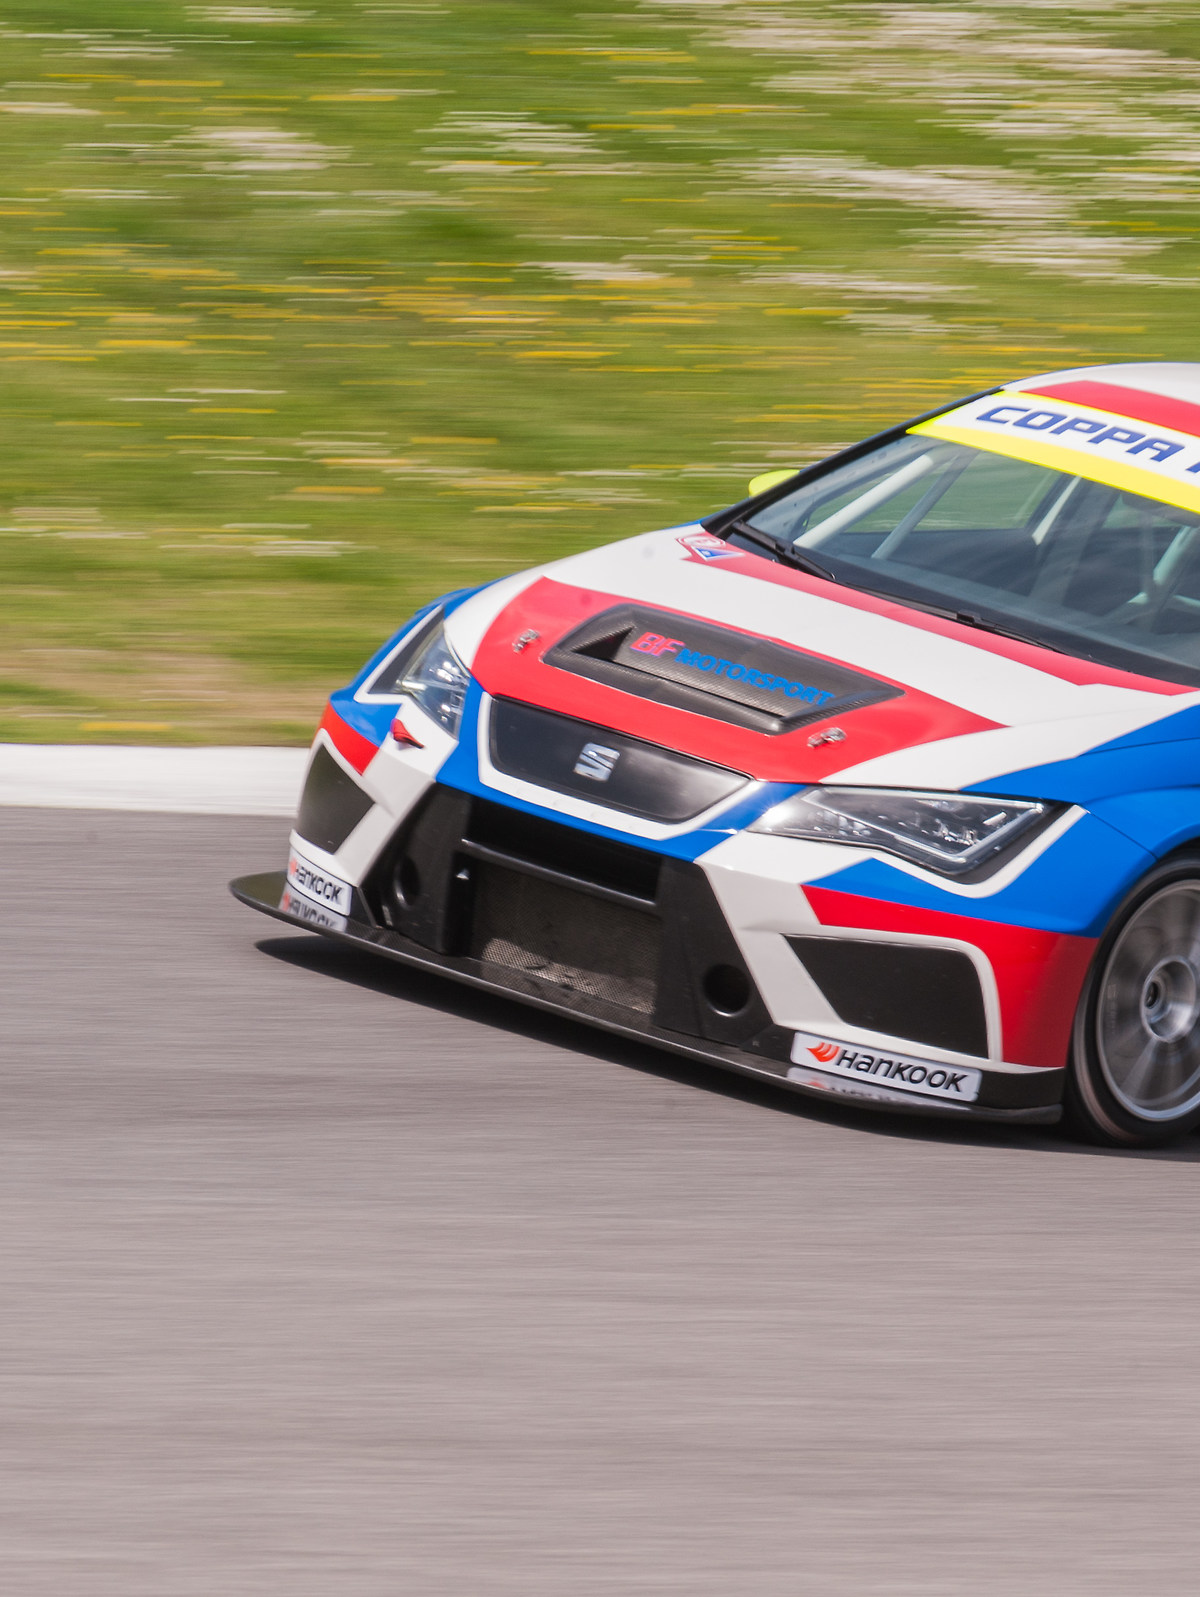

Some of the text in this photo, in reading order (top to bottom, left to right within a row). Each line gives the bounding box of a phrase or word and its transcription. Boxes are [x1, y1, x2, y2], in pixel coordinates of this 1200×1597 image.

[974, 406, 1185, 463] COPPA
[631, 631, 836, 706] BF MOTORSPORT
